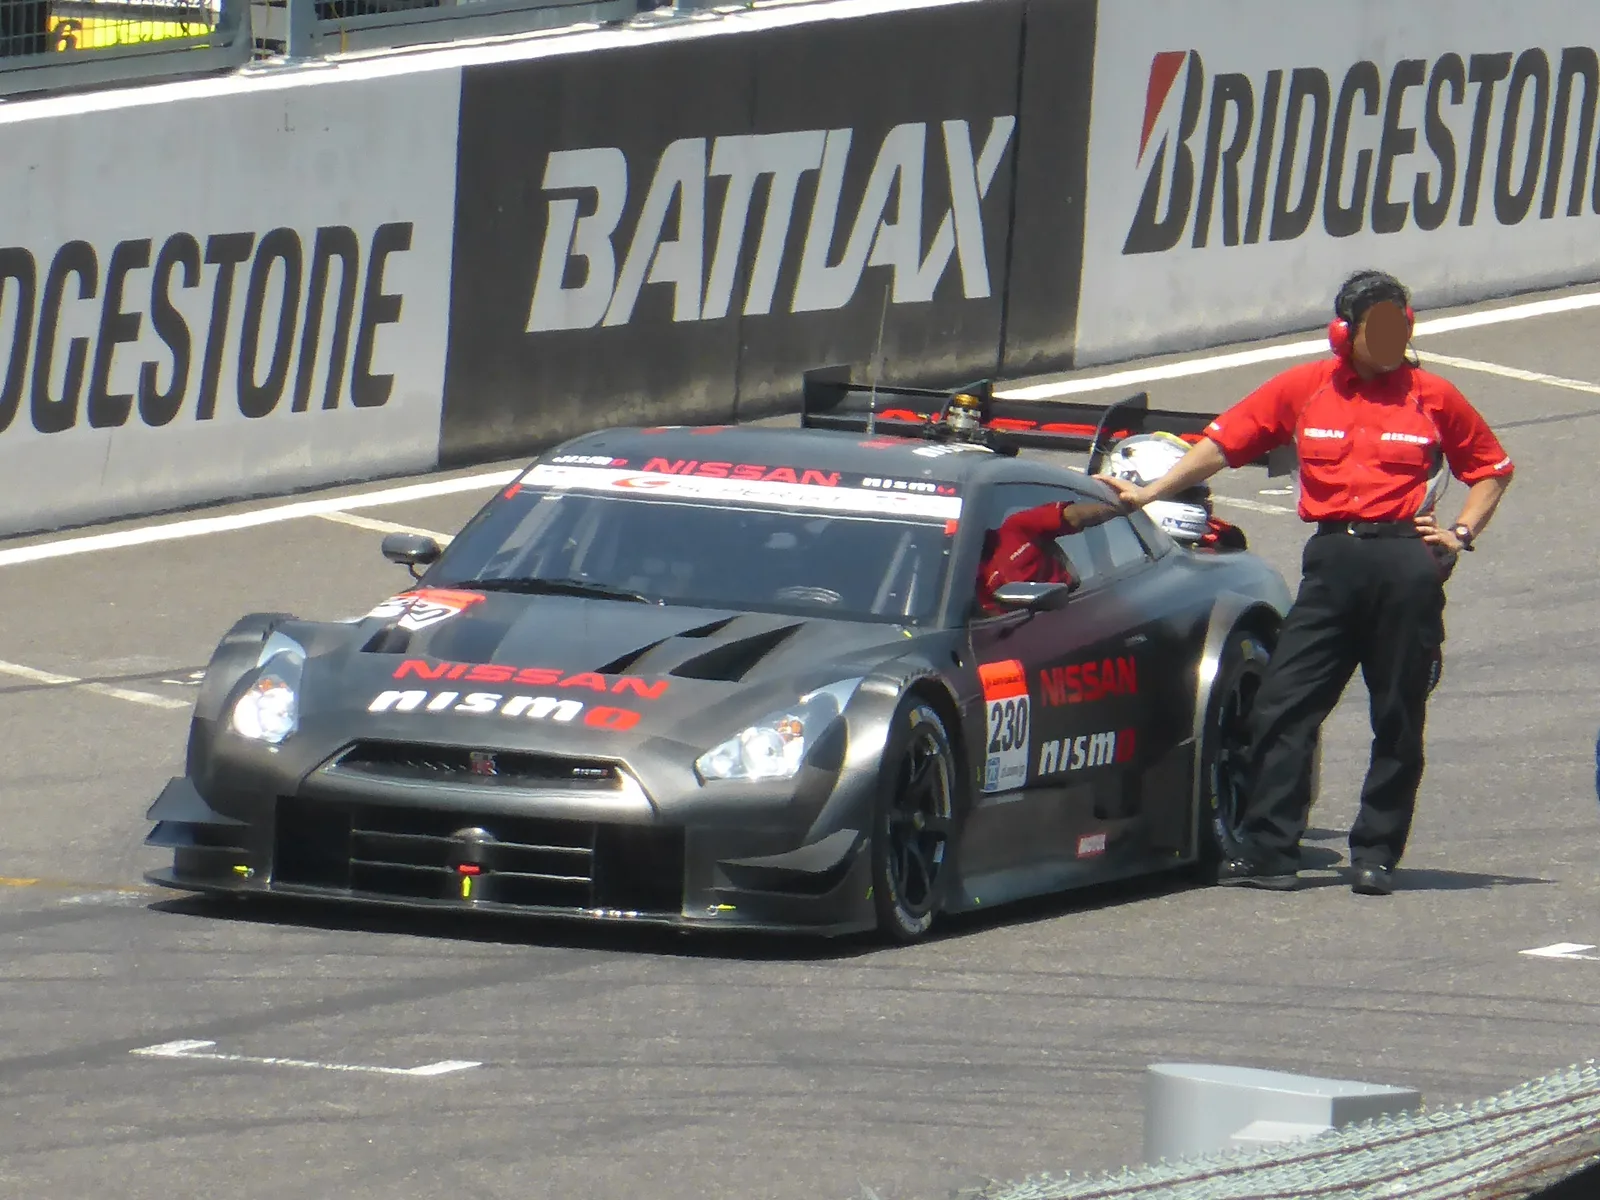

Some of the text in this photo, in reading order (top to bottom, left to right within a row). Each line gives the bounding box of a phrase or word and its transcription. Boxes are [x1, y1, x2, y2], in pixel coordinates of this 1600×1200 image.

[1121, 47, 1600, 255] BRIDGESTON
[526, 115, 1016, 333] BATTLAX
[642, 457, 840, 487] NISSAN
[393, 659, 670, 699] NISSAN
[1040, 655, 1138, 708] NISSAN
[988, 697, 1028, 753] 230
